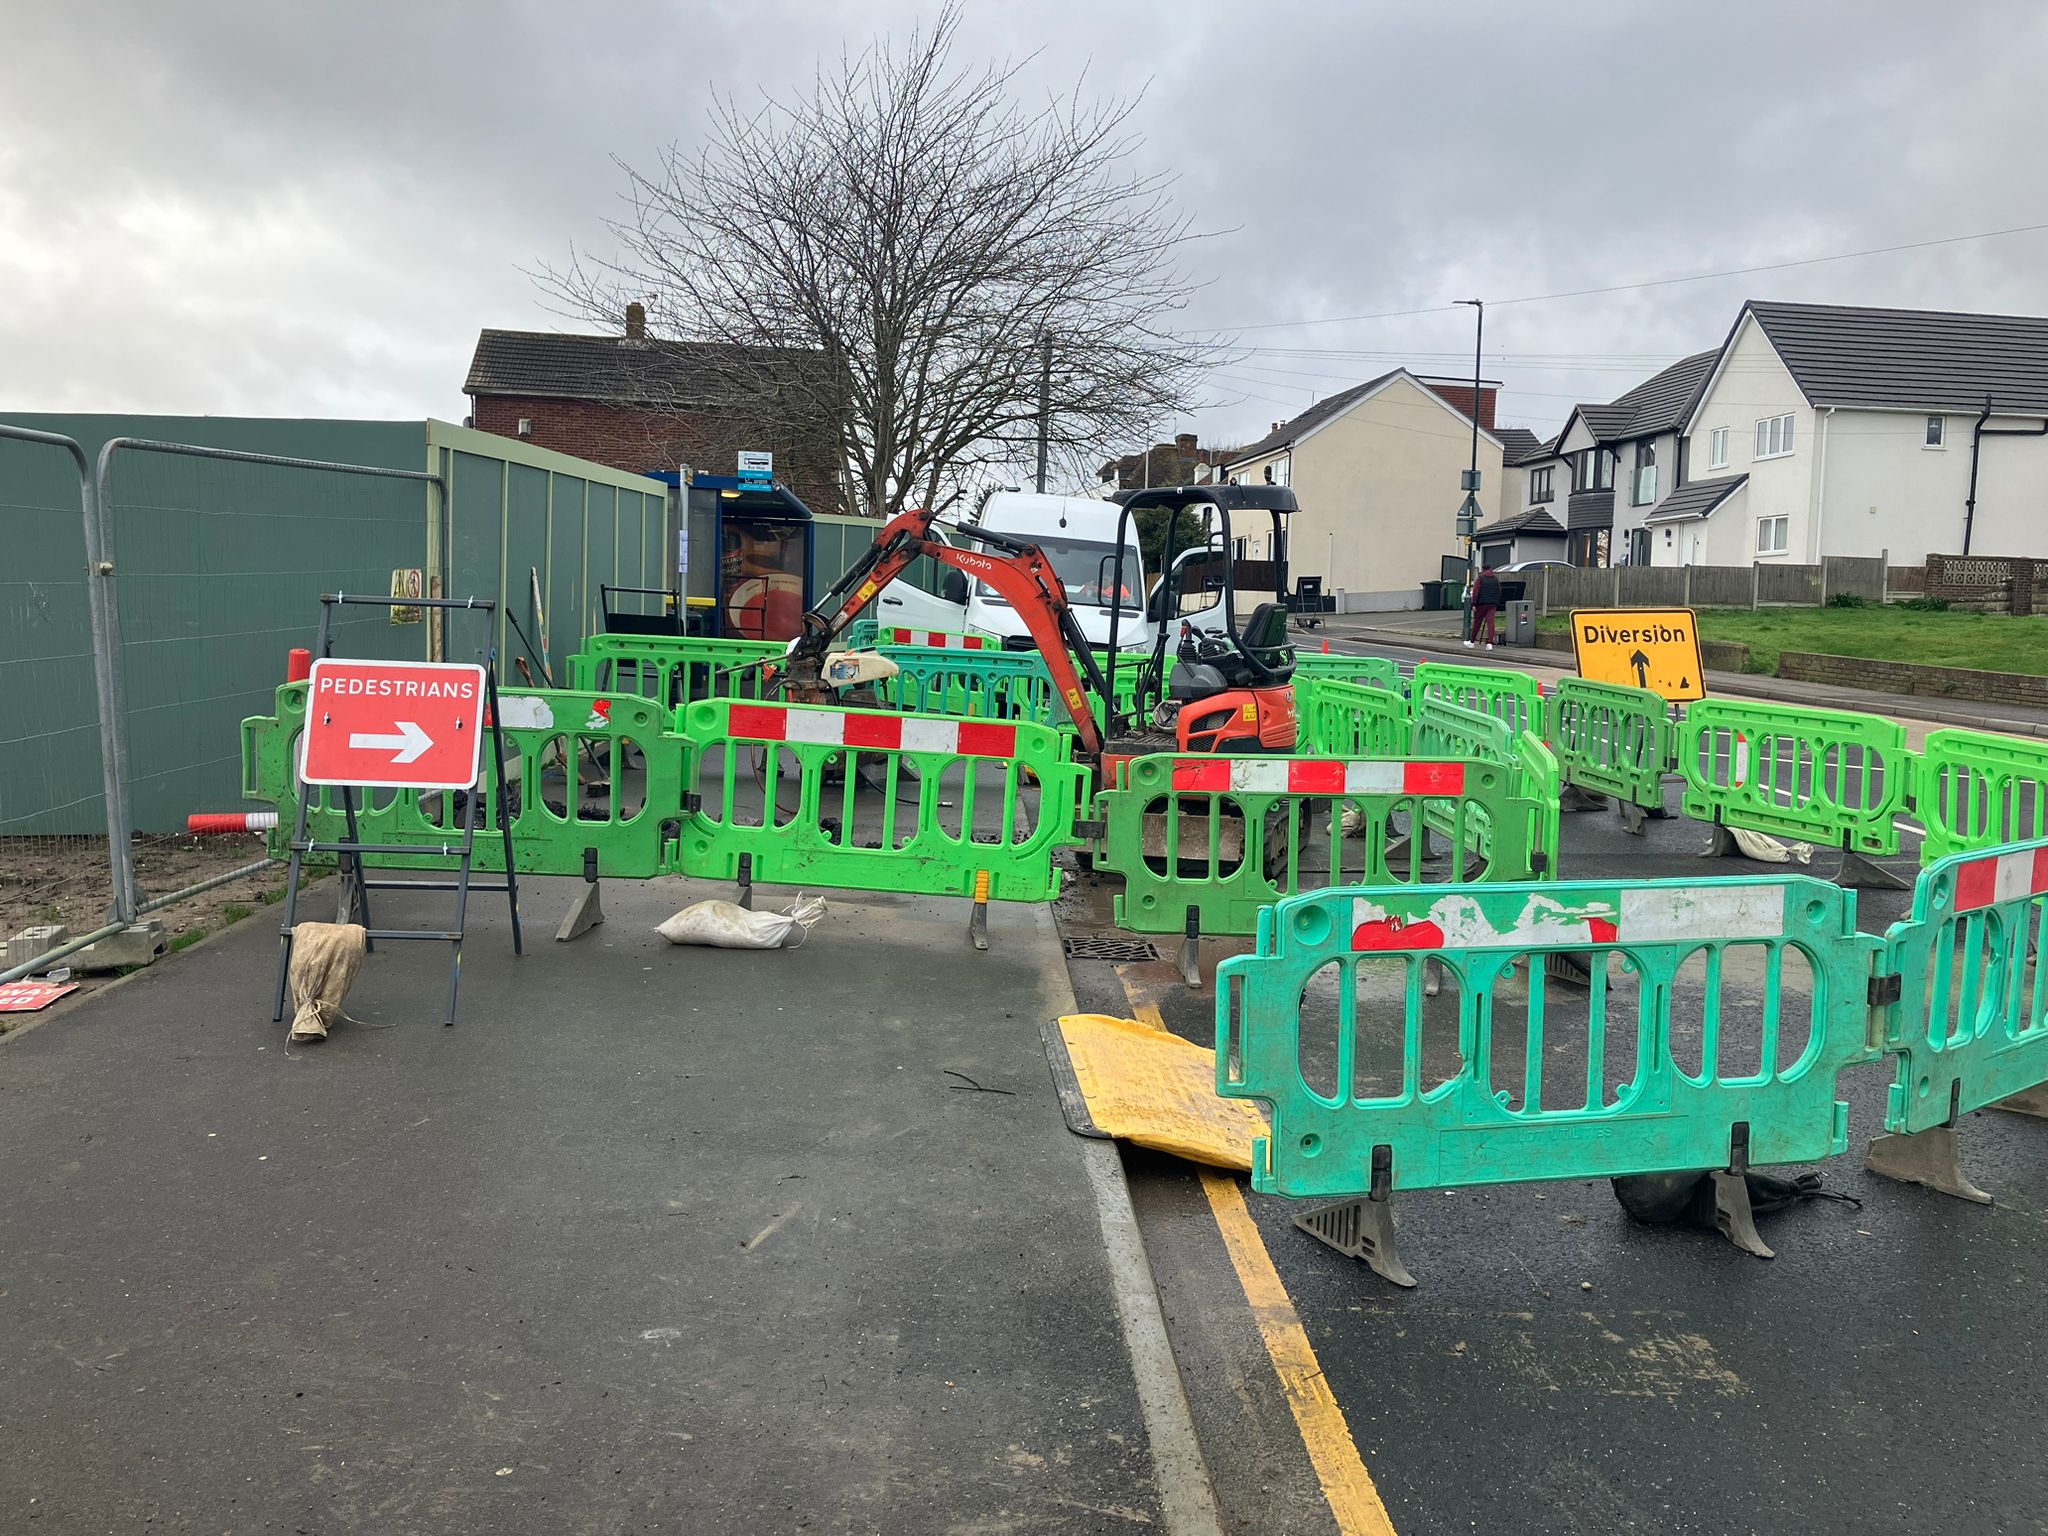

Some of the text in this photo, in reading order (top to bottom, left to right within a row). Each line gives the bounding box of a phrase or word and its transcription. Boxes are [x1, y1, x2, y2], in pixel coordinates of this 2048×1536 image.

[955, 553, 992, 570] Kubota
[1583, 624, 1686, 644] Diversion
[320, 677, 473, 699] PEDESTRIANS
